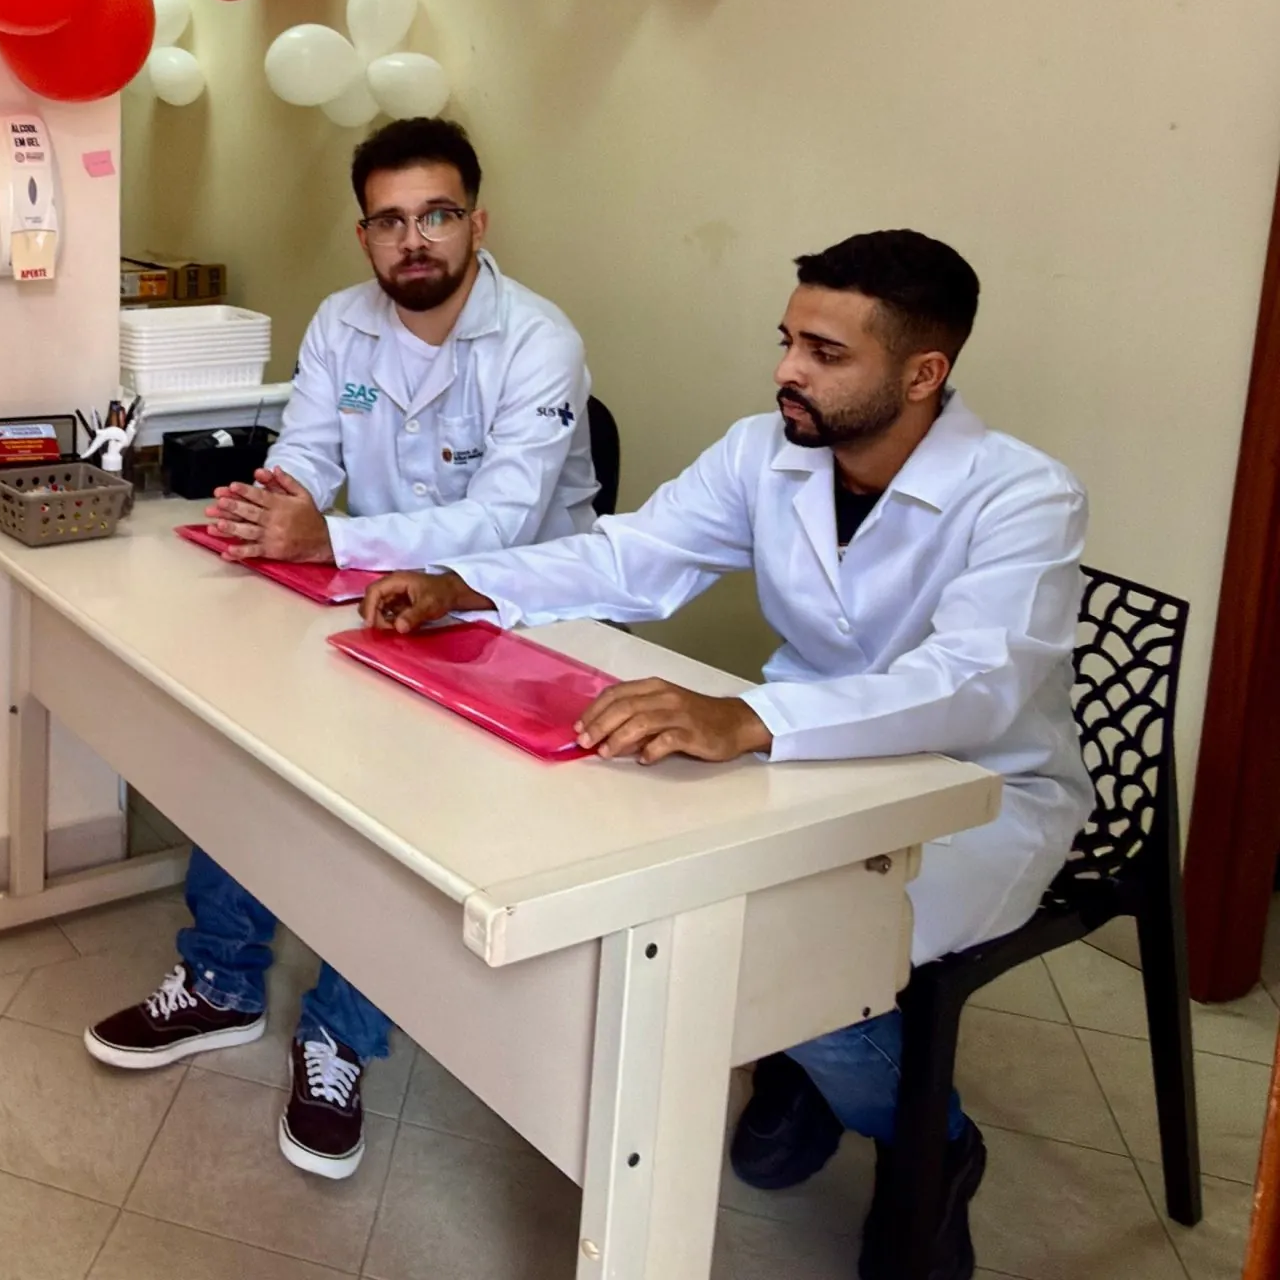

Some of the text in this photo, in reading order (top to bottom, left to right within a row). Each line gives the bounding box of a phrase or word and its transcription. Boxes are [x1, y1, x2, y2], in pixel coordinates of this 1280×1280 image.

[14, 136, 40, 147] EM GEL
[341, 382, 380, 403] SAS
[536, 406, 556, 417] SUS
